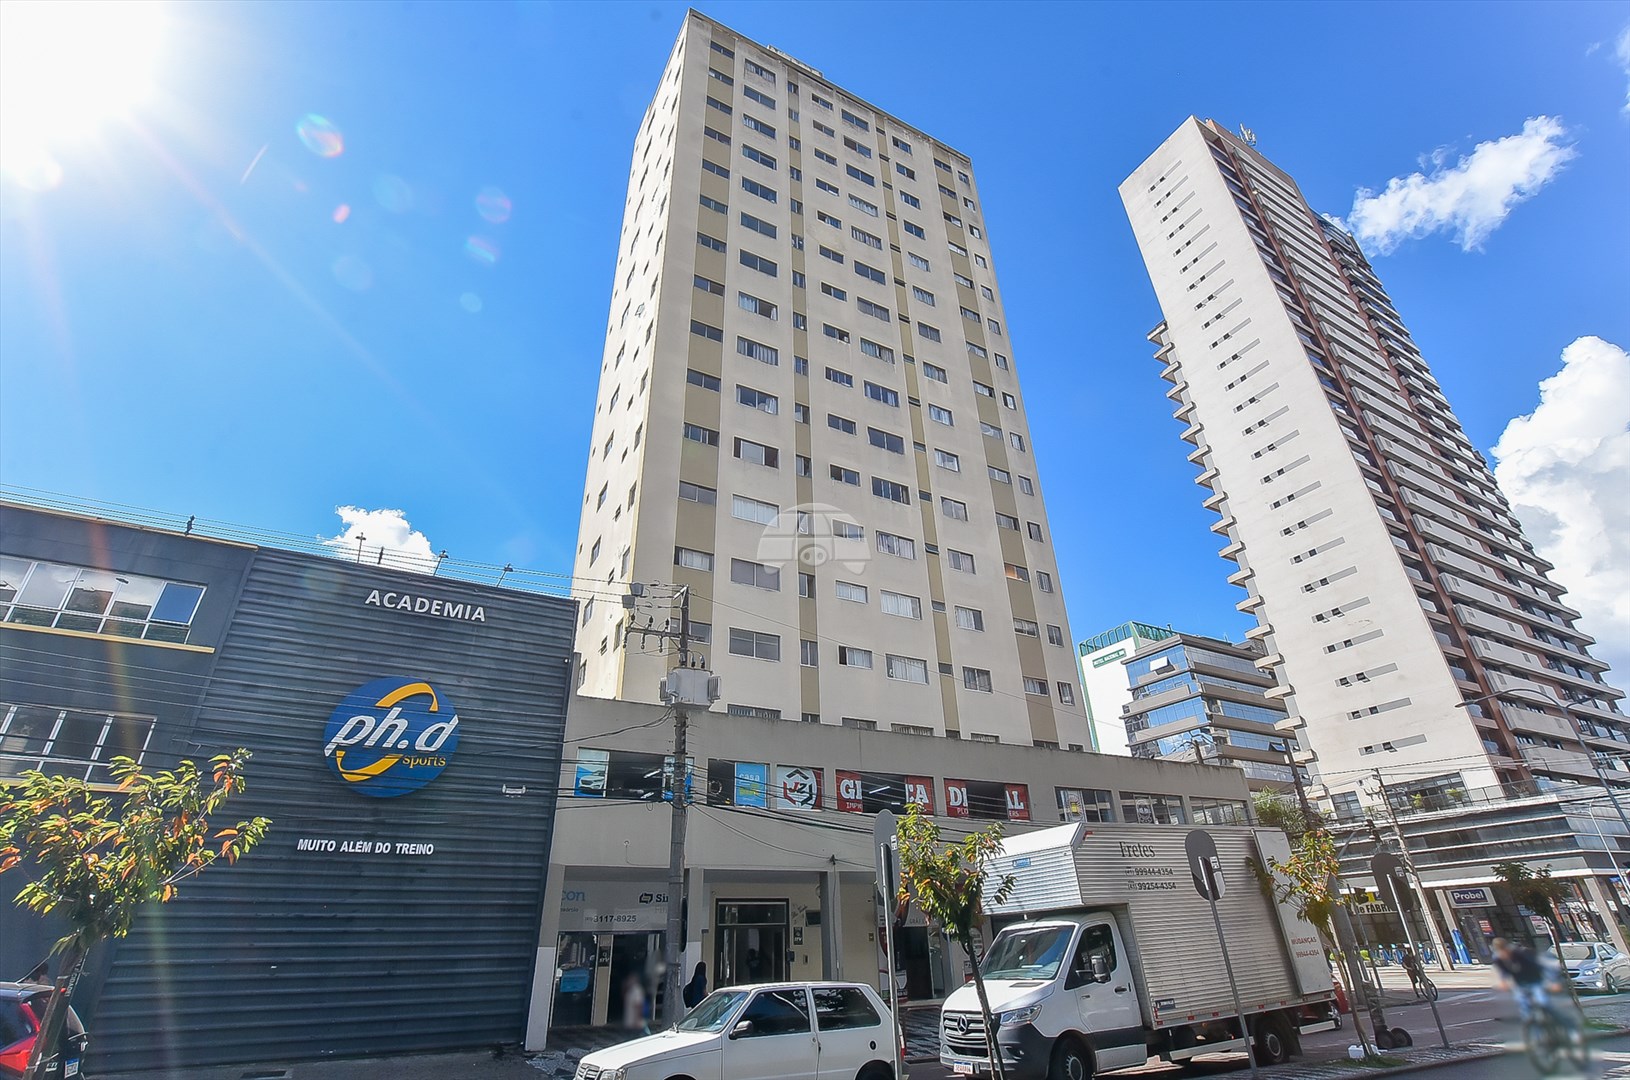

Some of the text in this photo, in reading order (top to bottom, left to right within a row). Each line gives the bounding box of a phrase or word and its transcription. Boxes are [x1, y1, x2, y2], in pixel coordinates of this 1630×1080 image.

[365, 589, 486, 622] ACADEMIA
[402, 754, 447, 769] sports
[297, 839, 434, 855] MUITO ALÉM DO TREINO
[1119, 841, 1156, 858] Fretes
[1134, 867, 1173, 876] 99944-4354
[1453, 890, 1485, 900] Probel
[593, 915, 637, 923] 3117-8925
